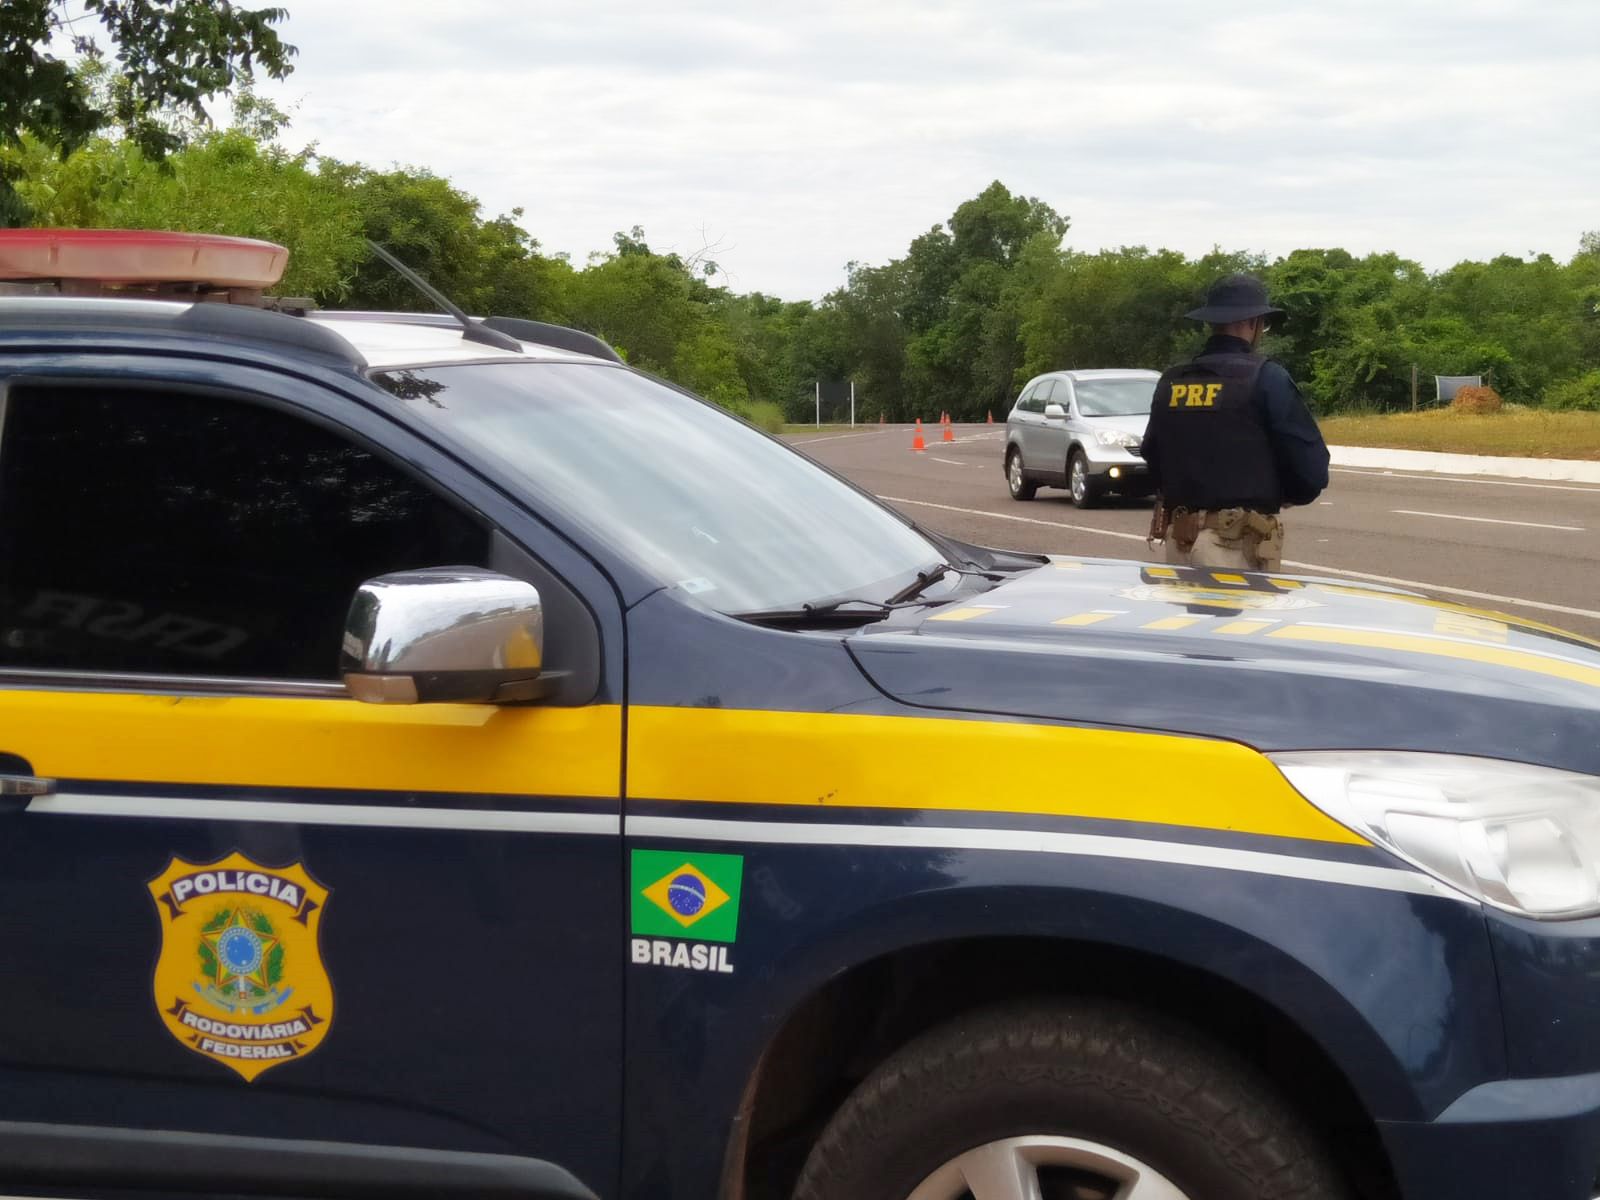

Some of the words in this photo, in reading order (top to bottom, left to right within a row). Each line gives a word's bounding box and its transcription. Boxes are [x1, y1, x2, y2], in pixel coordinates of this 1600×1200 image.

[1169, 384, 1222, 407] PRF
[172, 871, 299, 907] POLÍCIA
[631, 939, 734, 973] BRASIL
[183, 1012, 306, 1040] RODOVIÁRIA
[201, 1038, 292, 1059] FEDERAL
